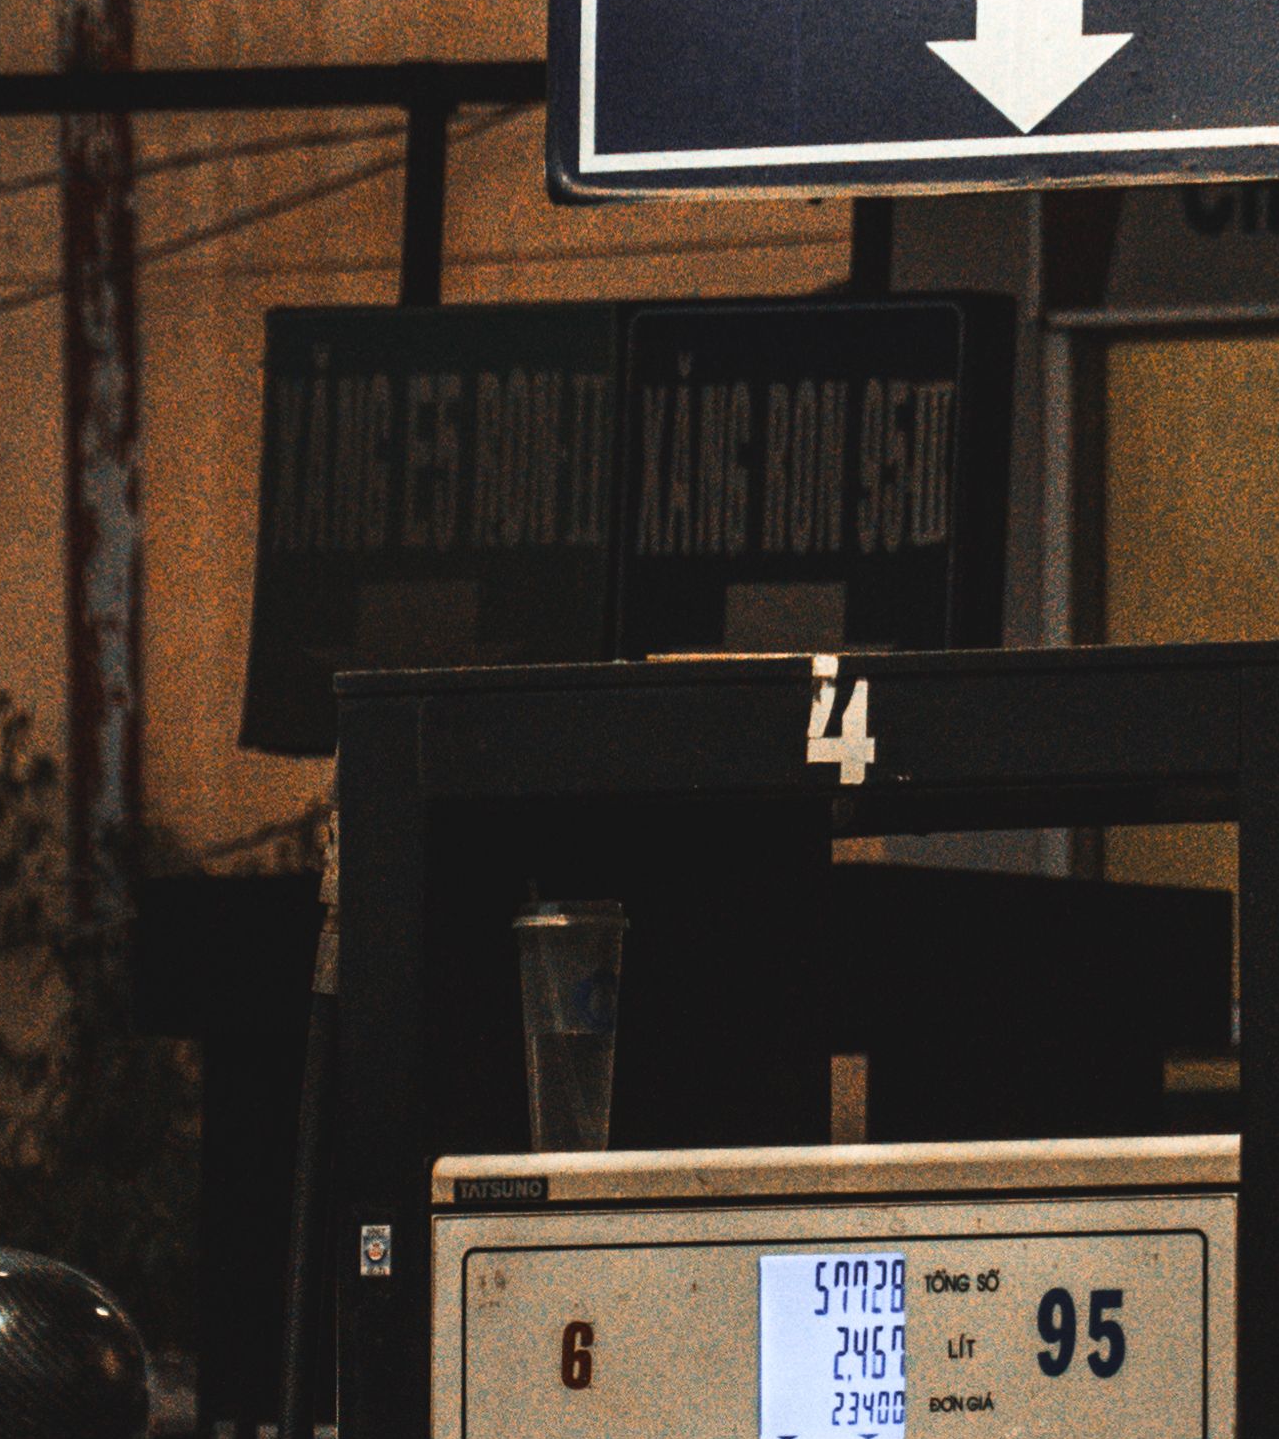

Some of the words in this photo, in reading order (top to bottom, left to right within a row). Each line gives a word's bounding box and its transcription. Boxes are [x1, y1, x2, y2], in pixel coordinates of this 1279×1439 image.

[271, 342, 391, 551] XĂNG
[635, 351, 752, 556] XĂNG
[762, 379, 849, 554] RON
[807, 655, 875, 784] 4
[458, 1178, 543, 1199] TATSUNO
[814, 1260, 905, 1315] 57728
[561, 1321, 594, 1390] 6
[947, 1333, 976, 1359] LÍT
[1037, 1287, 1125, 1378] 95
[832, 1391, 905, 1426] 23400
[966, 1392, 995, 1412] GIÁ
